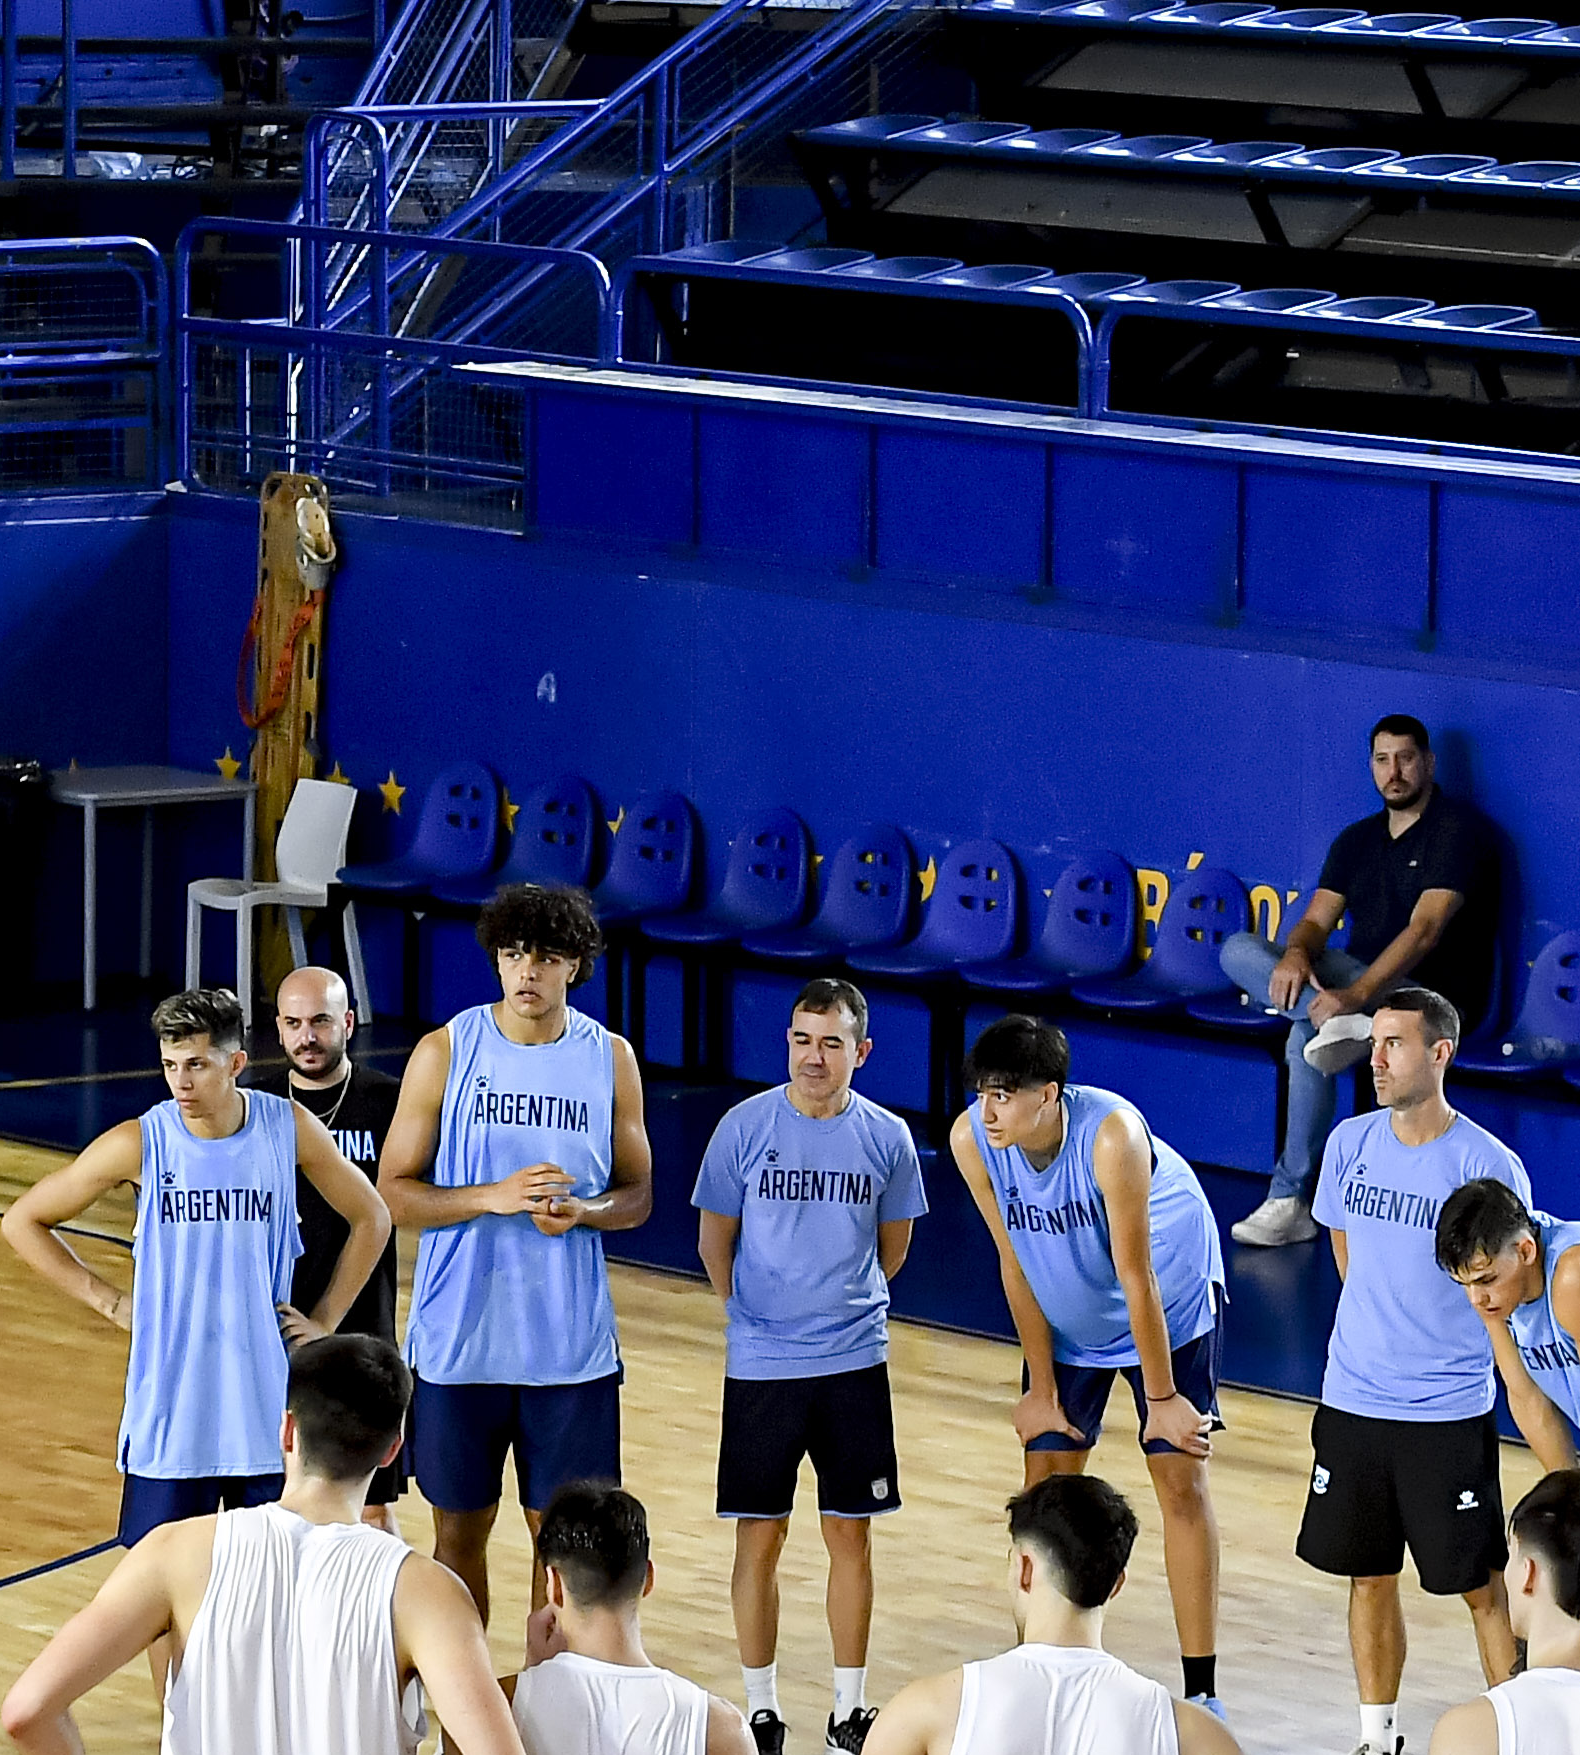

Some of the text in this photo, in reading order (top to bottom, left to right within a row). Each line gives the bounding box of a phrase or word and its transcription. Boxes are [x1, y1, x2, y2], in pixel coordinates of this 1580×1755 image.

[474, 1092, 589, 1134] ARGENTINA
[758, 1169, 873, 1205] ARGENTINA
[1344, 1181, 1439, 1231] ARGENTIN
